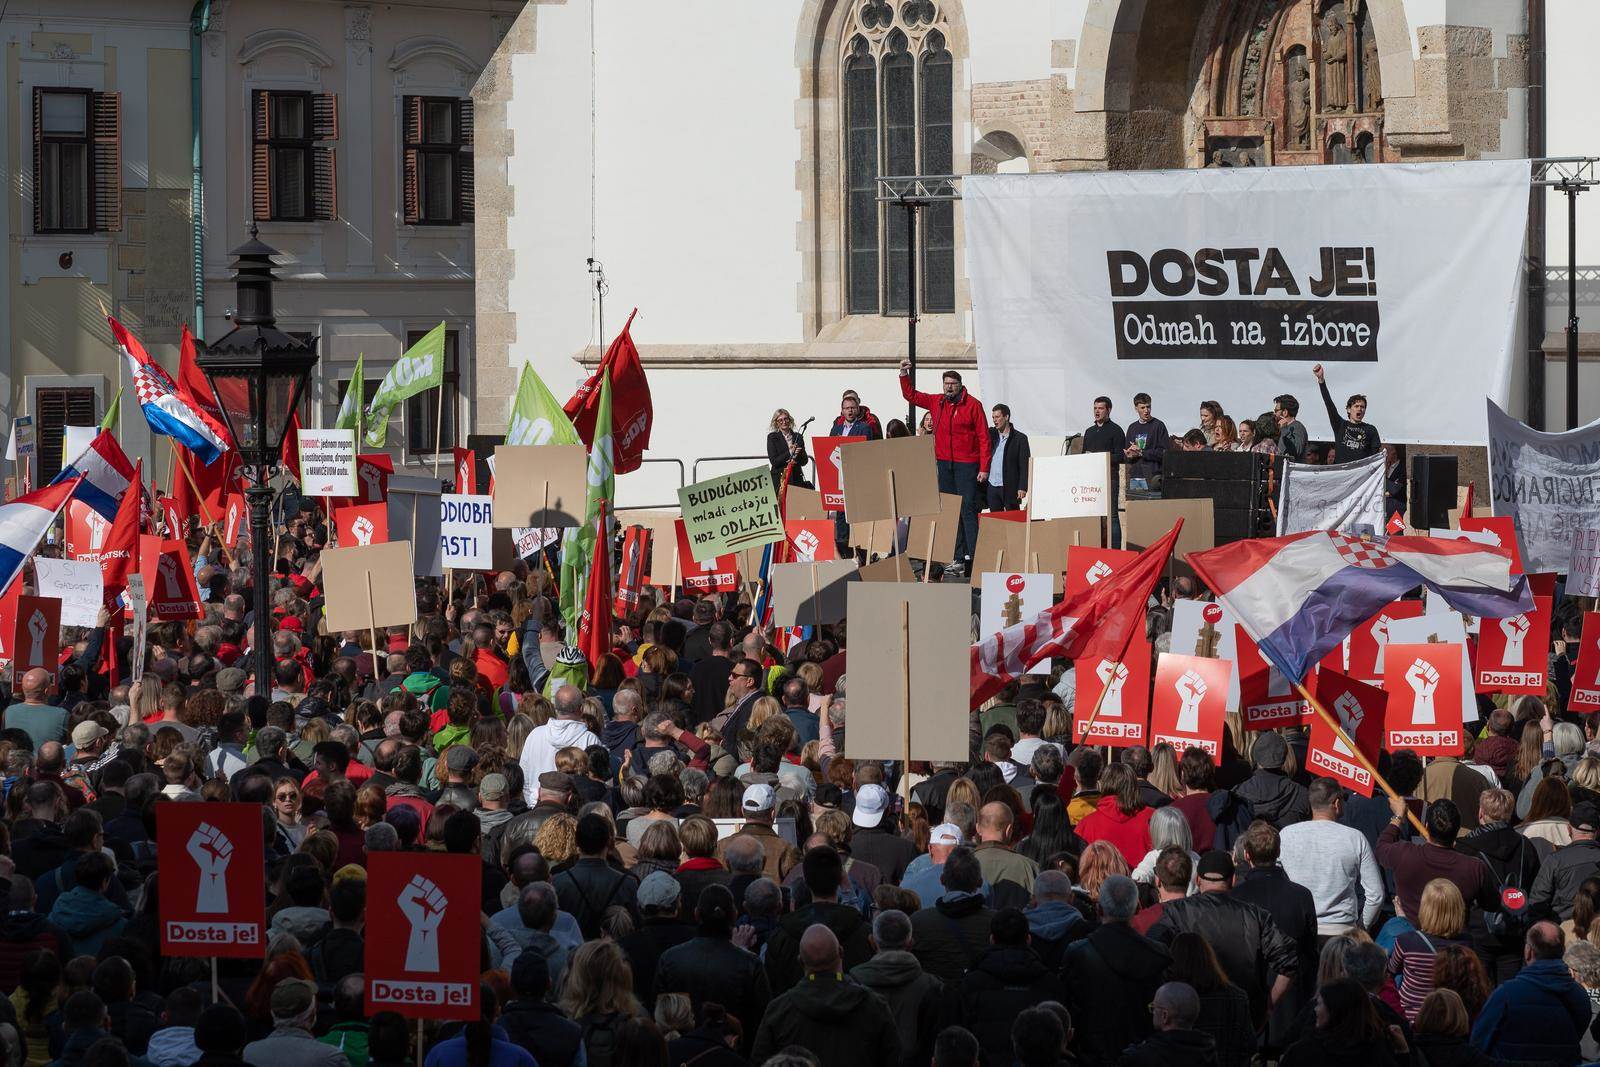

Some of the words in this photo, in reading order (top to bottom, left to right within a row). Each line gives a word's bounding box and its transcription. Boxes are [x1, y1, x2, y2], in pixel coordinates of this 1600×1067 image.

[1107, 247, 1300, 297] DOSTA
[1309, 246, 1377, 297] JE!
[1123, 314, 1218, 346] Odmah
[1230, 320, 1266, 346] na
[1280, 314, 1371, 347] izbore
[688, 474, 769, 507] BUDUĆNOST:
[693, 506, 726, 524] mladi
[731, 495, 769, 514] ostaju
[694, 530, 716, 545] HDZ
[720, 504, 781, 537] ODLAZI!
[687, 575, 718, 588] Dosta
[720, 574, 734, 586] je!
[1010, 577, 1025, 586] SDP
[158, 603, 185, 614] Dosta
[1207, 606, 1223, 616] SDP
[1482, 674, 1521, 685] Dosta
[1524, 674, 1541, 687] je!
[1250, 706, 1292, 720] Dosta
[1079, 722, 1119, 735] Dosta
[1122, 724, 1140, 738] je!
[1392, 733, 1434, 745] Dosta
[1437, 732, 1456, 747] je!
[1312, 750, 1351, 776] Dosta
[1352, 767, 1370, 785] je!
[1508, 891, 1523, 899] SDP
[169, 924, 226, 942] Dosta
[231, 924, 257, 944] je!
[375, 983, 437, 1002] Dosta
[441, 986, 469, 1006] je!
